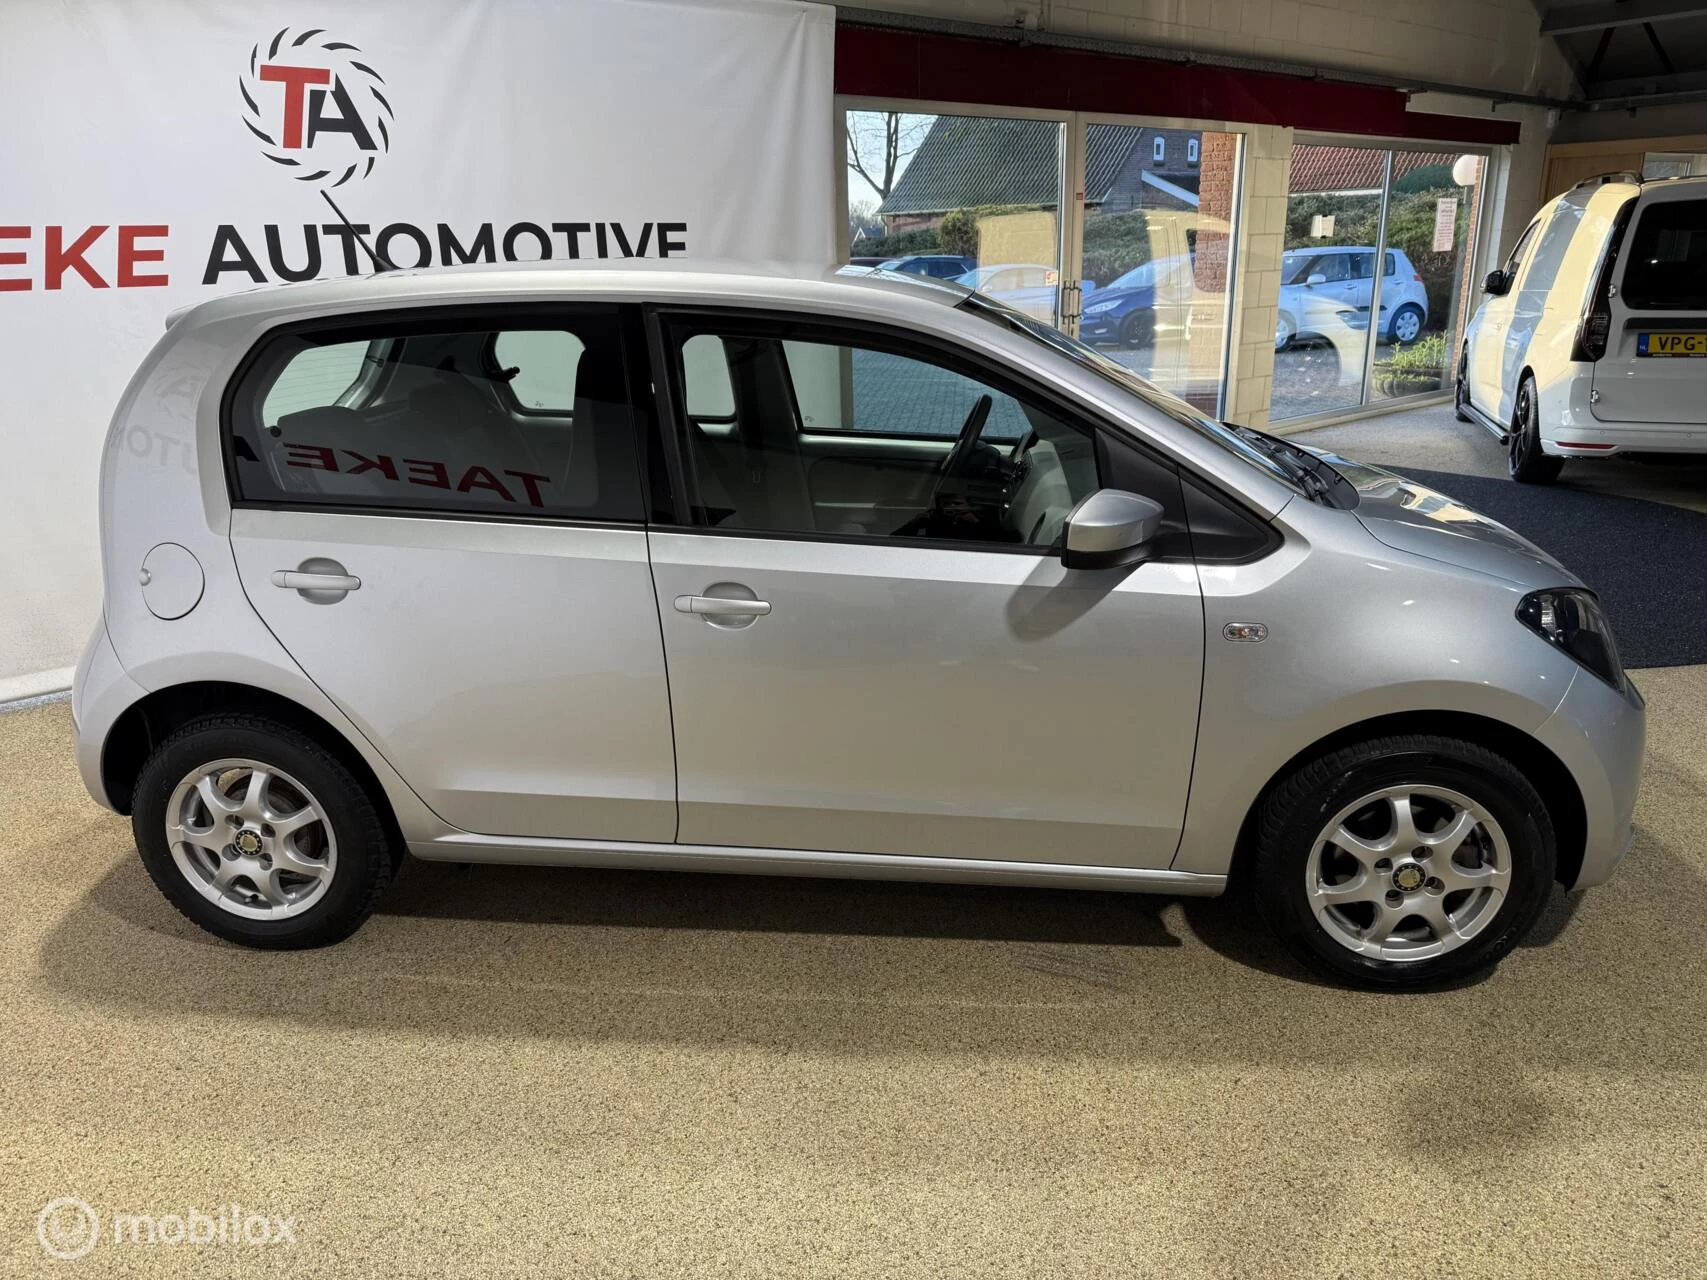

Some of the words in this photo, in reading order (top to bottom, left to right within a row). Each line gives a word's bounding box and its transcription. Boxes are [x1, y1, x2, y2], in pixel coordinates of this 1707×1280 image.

[260, 64, 379, 151] TA
[202, 222, 688, 285] AUTOMOTIVE
[1658, 336, 1707, 351] VPG-
